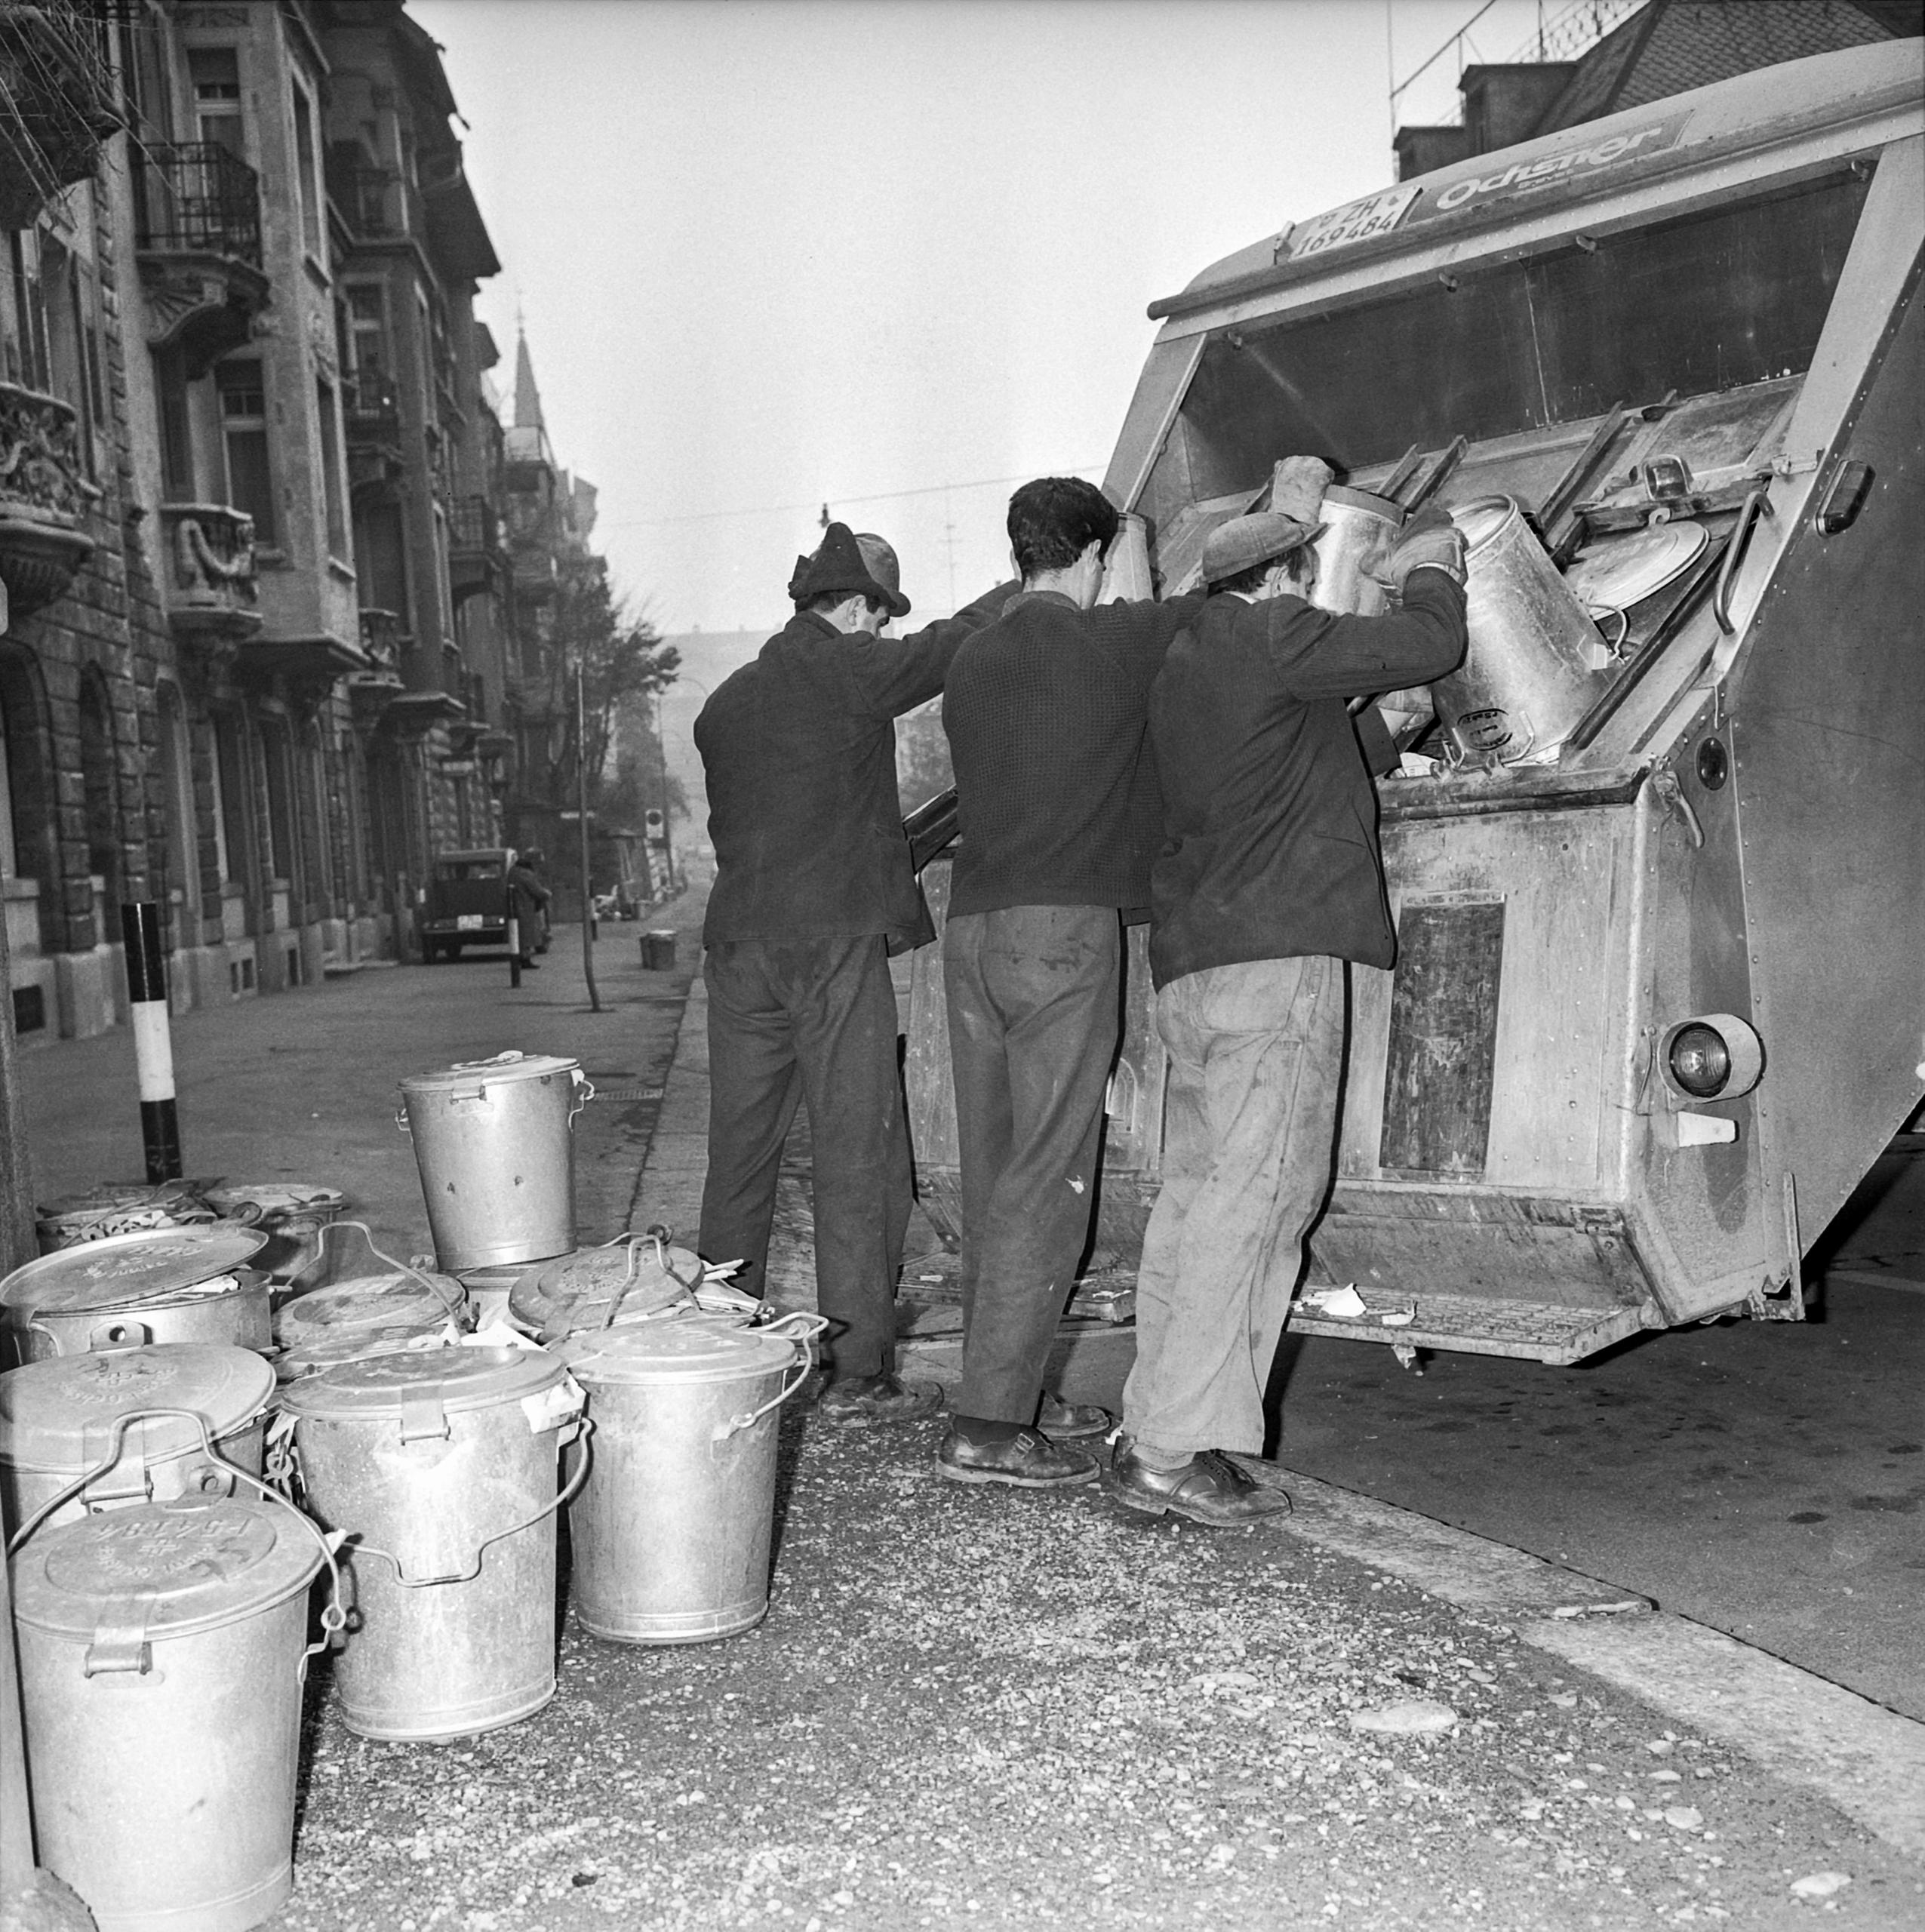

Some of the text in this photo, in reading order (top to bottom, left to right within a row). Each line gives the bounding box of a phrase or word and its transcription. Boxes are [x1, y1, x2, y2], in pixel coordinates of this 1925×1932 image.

[1436, 128, 1662, 210] Ochsner
[1341, 196, 1384, 225] ZH
[1298, 211, 1397, 255] 169484
